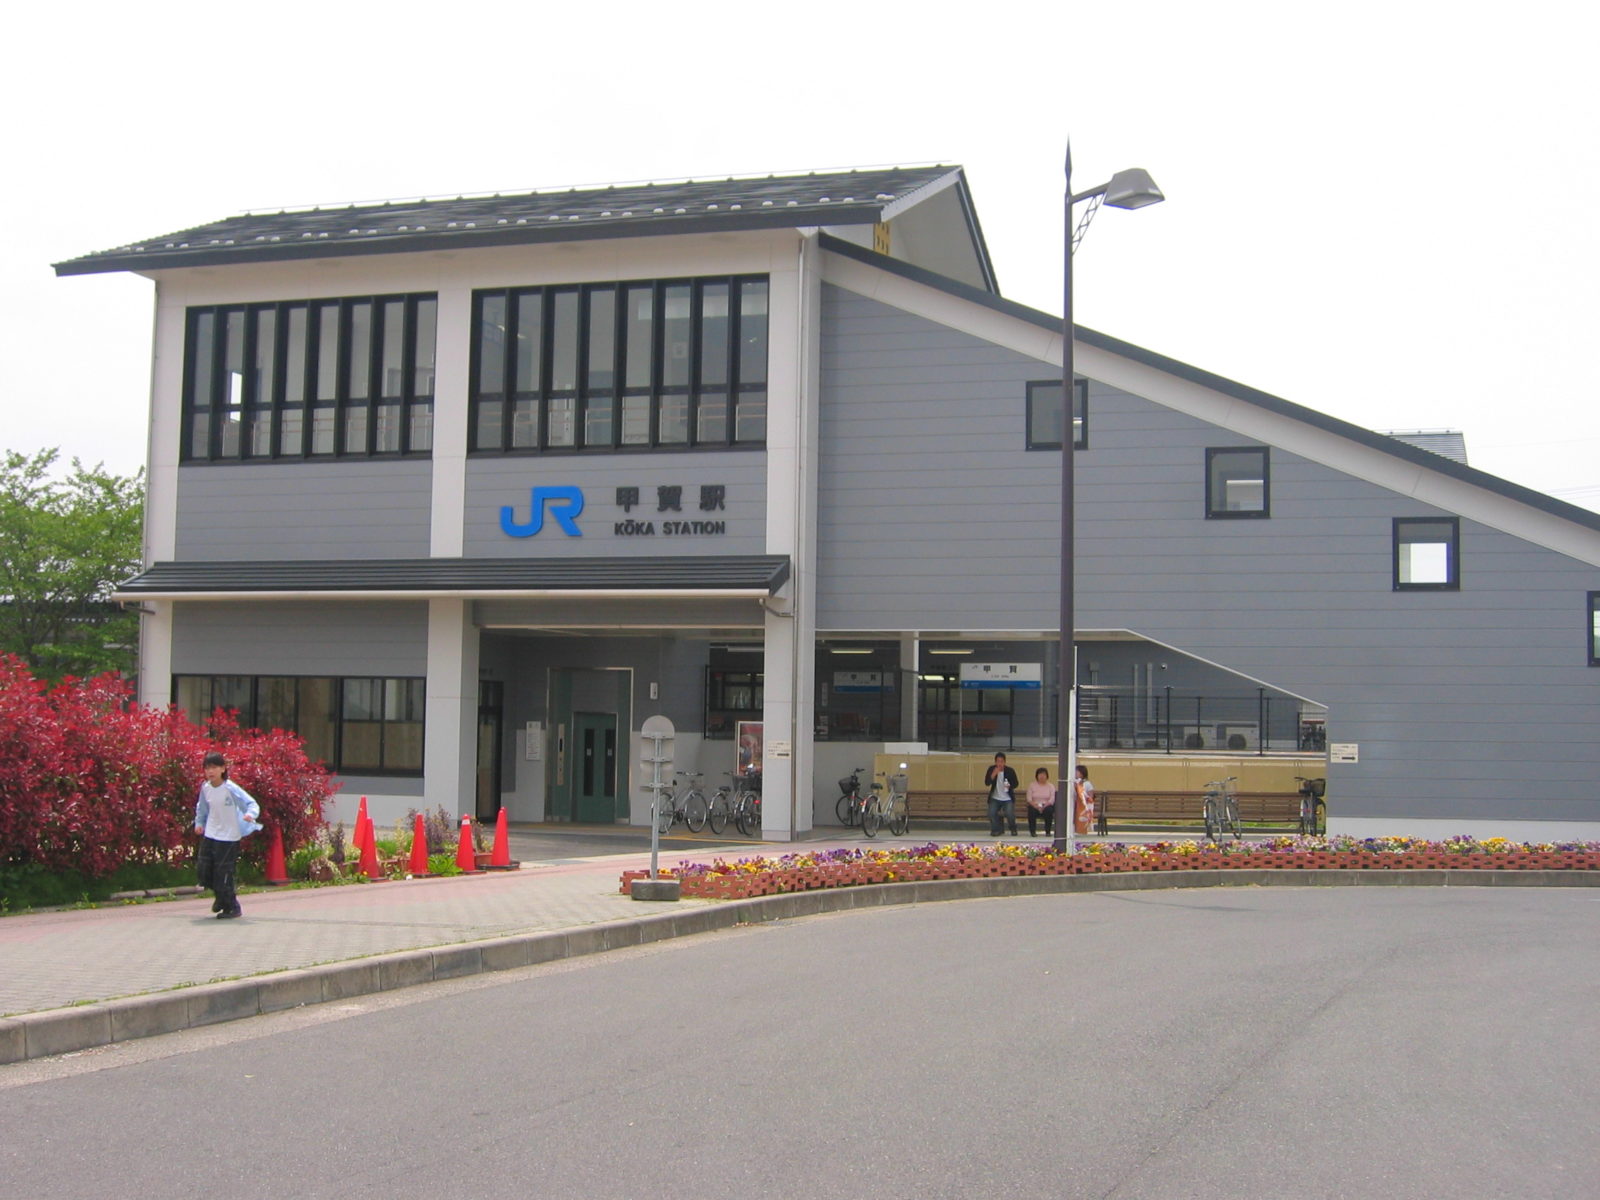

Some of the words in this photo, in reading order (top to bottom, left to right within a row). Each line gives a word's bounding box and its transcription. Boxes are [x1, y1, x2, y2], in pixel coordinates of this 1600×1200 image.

[499, 486, 584, 538] JR
[615, 485, 725, 513] 甲賀駅
[663, 521, 725, 535] STATION
